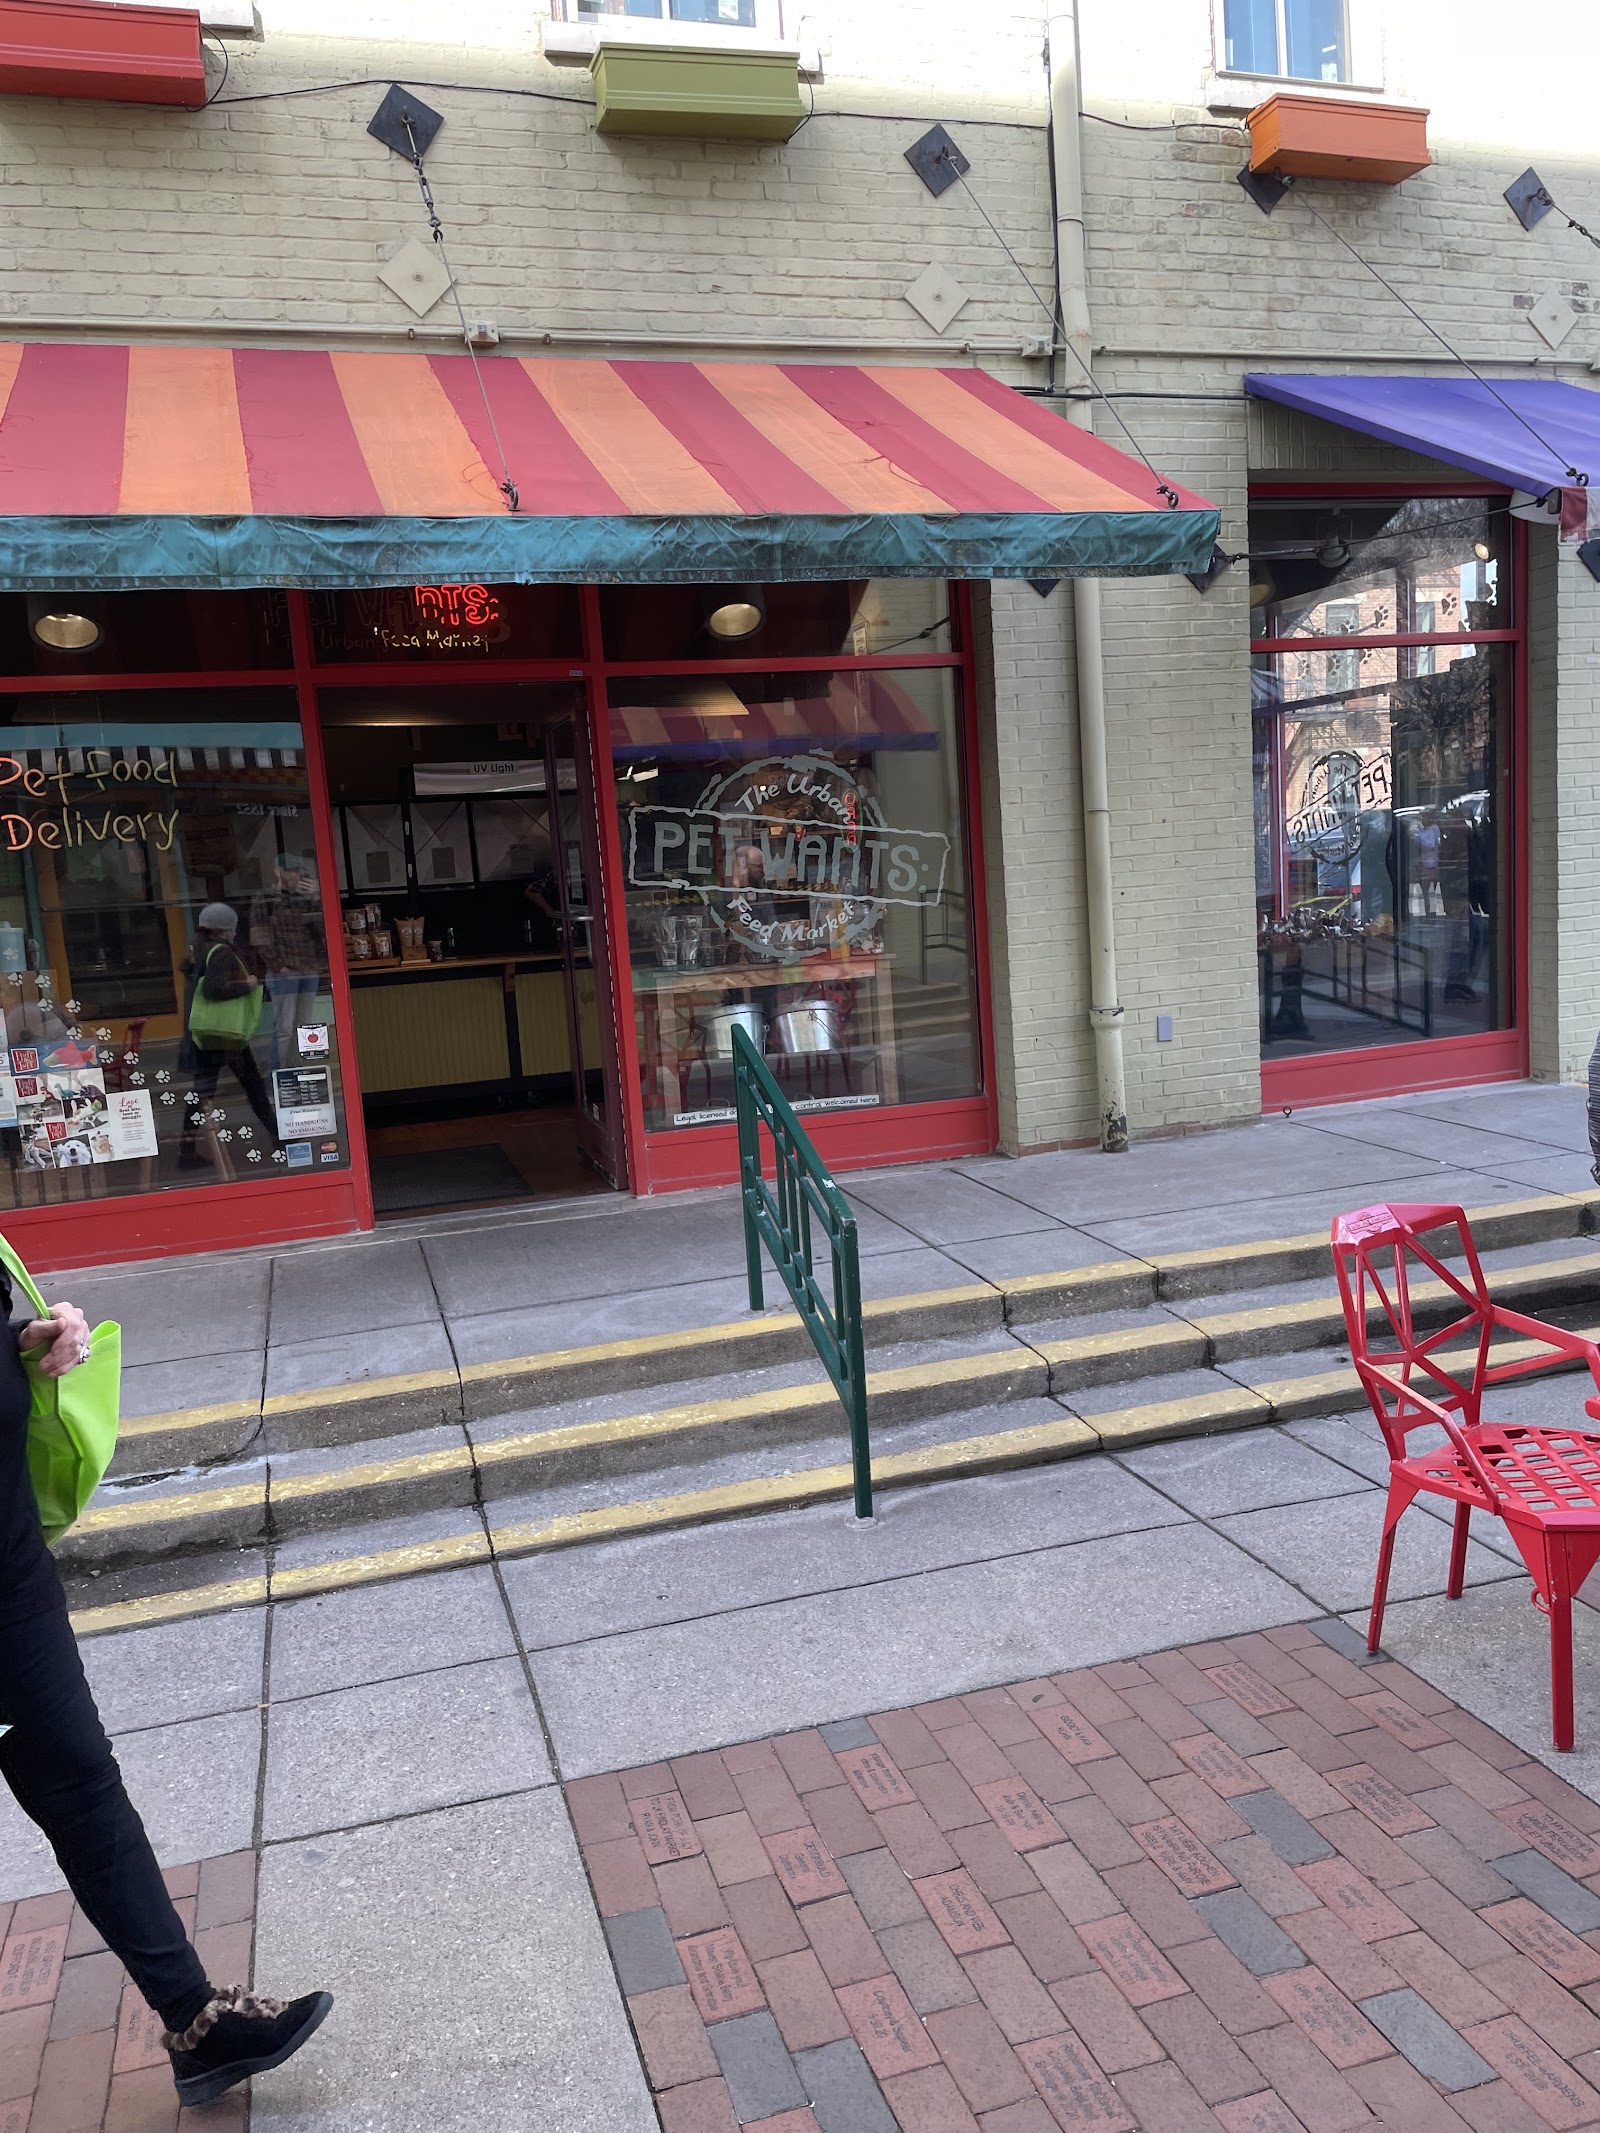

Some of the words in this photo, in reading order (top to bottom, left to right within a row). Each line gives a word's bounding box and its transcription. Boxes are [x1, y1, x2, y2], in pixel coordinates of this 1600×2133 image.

[473, 764, 488, 773] UV
[490, 763, 514, 774] Light
[734, 782, 780, 812] The
[786, 772, 856, 826] Urban
[1, 806, 179, 850] Delivery
[653, 821, 743, 878] PET
[726, 895, 776, 944] Feed
[780, 899, 856, 943] Market
[824, 1096, 859, 1106] welcomed
[295, 1118, 329, 1127] HANDGUNS
[676, 1113, 697, 1124] Legal
[699, 1108, 728, 1119] licensed
[298, 1125, 328, 1134] SMOKING
[664, 1797, 678, 1812] FROM
[649, 1796, 661, 1805] TO
[663, 1834, 681, 1857] MARKET
[1561, 1830, 1596, 1853] FATHER
[959, 1902, 977, 1916] AND
